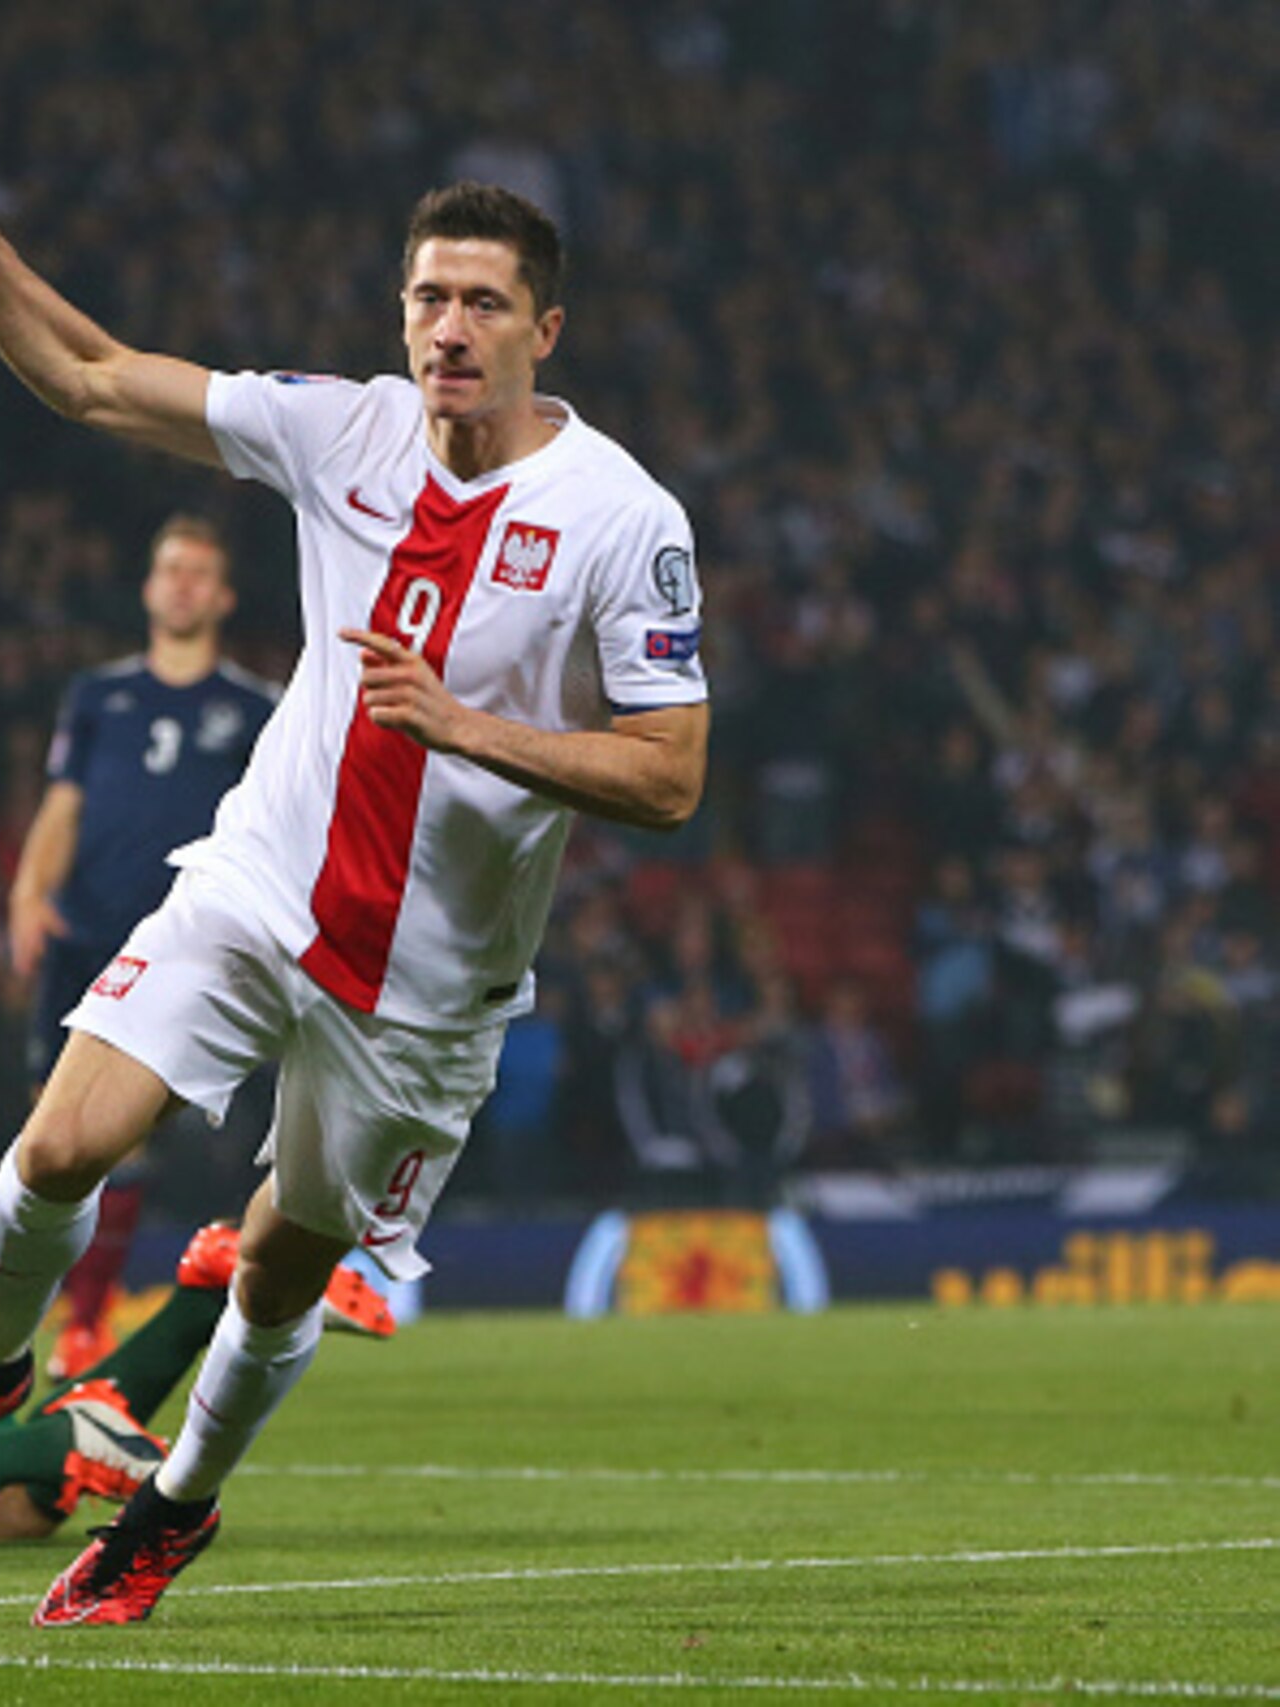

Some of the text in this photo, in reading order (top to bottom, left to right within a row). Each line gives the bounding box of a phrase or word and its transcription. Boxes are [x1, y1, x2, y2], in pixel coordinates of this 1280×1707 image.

[398, 578, 441, 654] 9
[144, 717, 182, 774] 3
[374, 1149, 425, 1217] 9
